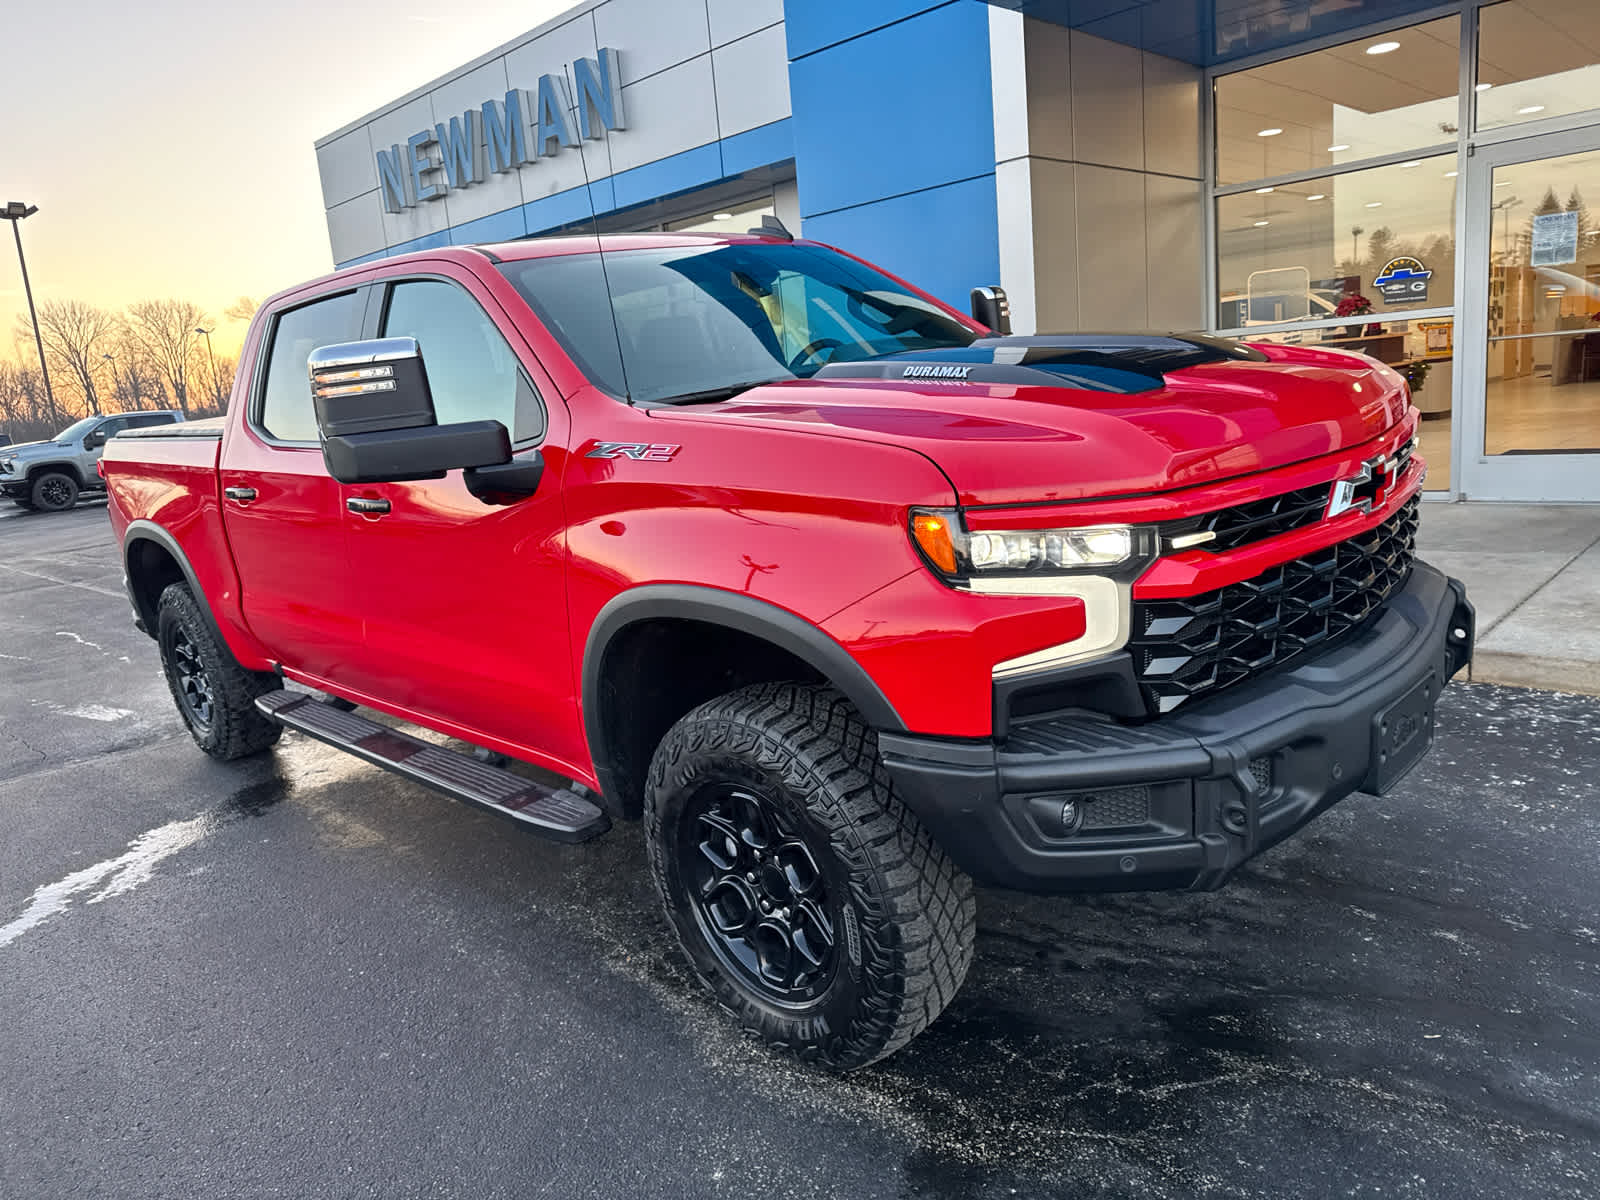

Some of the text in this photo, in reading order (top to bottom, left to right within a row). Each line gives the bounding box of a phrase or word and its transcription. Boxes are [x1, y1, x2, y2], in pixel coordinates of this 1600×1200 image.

[376, 47, 627, 214] NEWMAN
[903, 365, 972, 379] DURAMAX
[584, 441, 681, 462] ZR2
